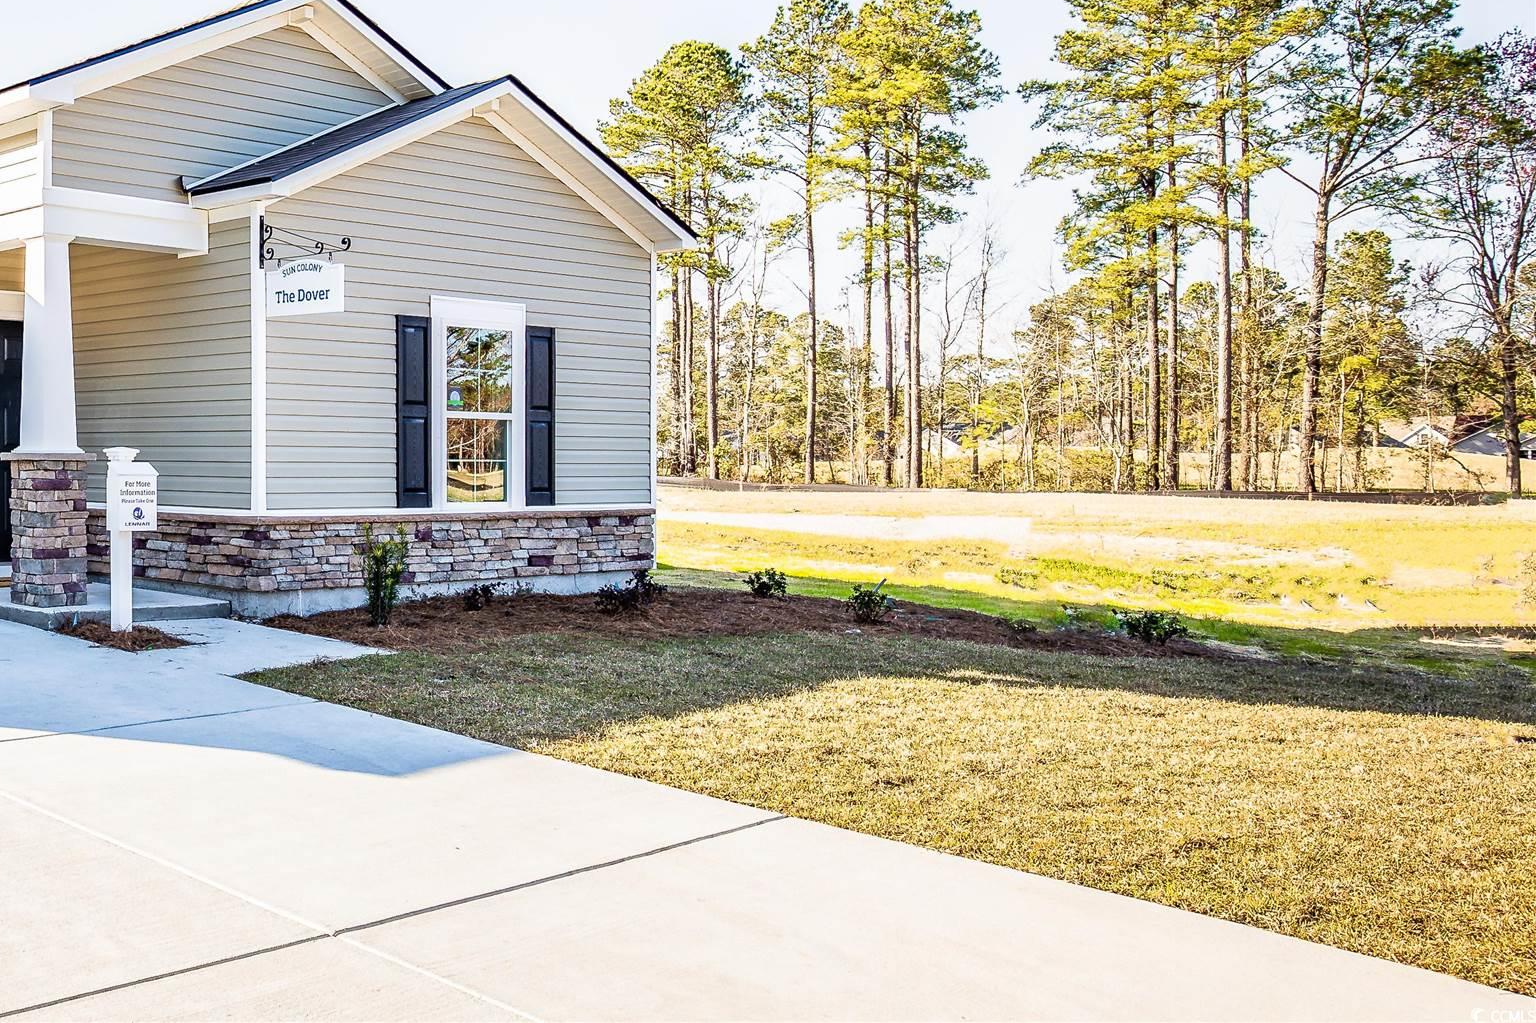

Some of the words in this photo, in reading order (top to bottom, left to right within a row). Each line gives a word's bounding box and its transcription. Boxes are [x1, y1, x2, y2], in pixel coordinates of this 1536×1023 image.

[282, 265, 296, 278] SUN
[296, 263, 323, 273] COLONY
[275, 289, 295, 304] The
[297, 288, 330, 302] Dover
